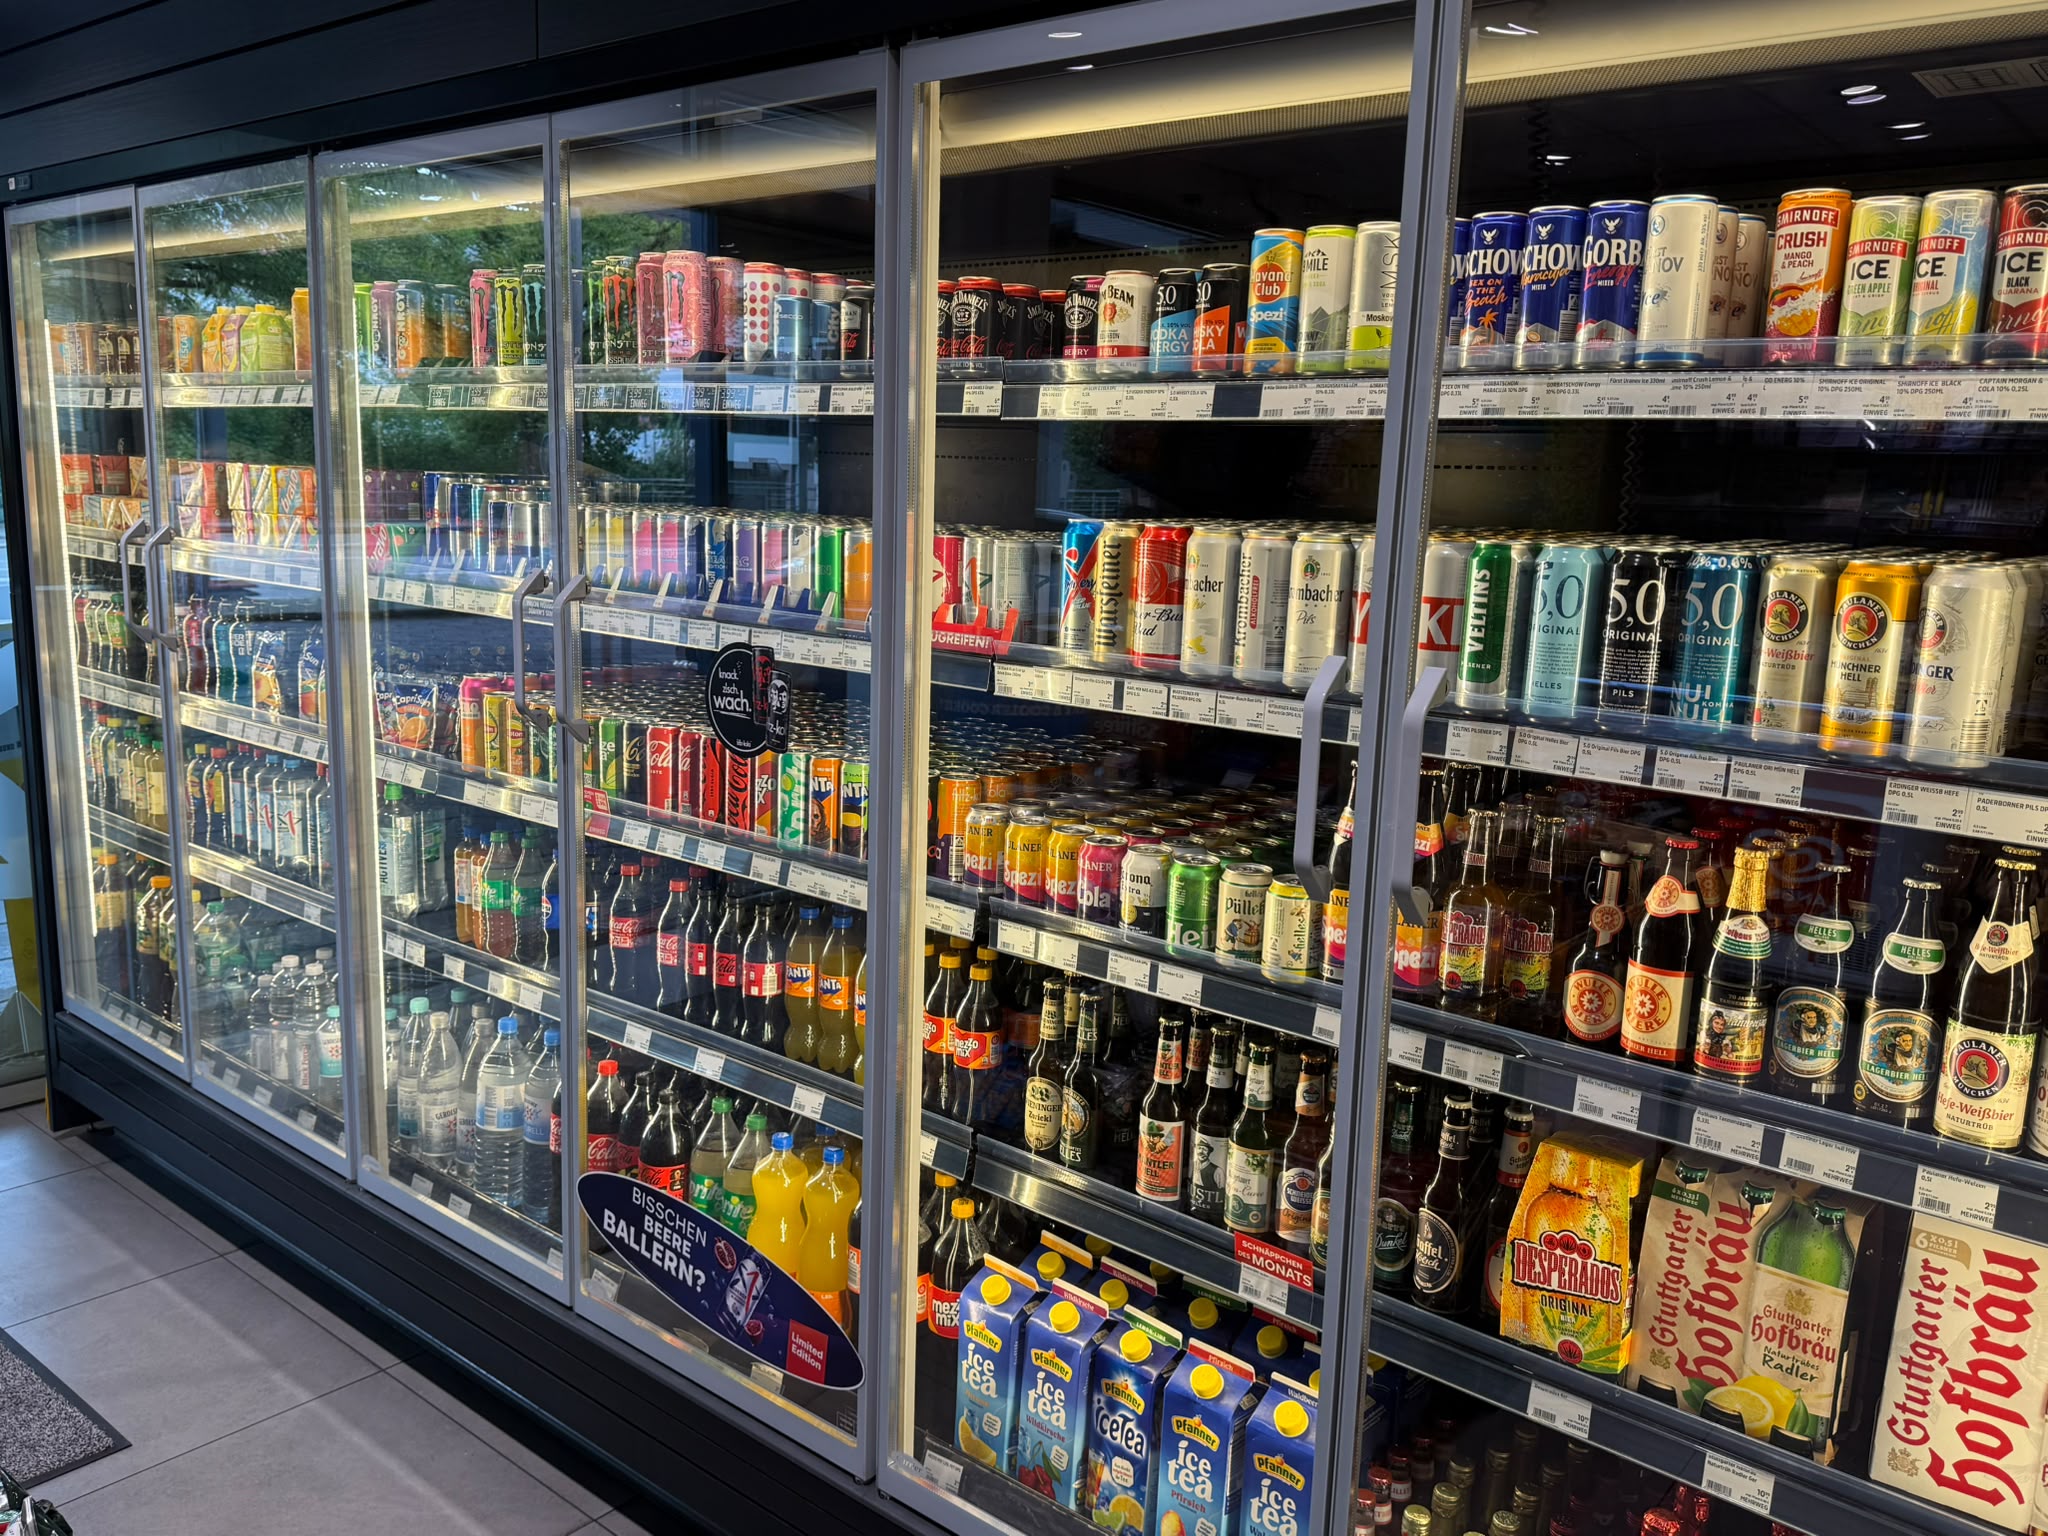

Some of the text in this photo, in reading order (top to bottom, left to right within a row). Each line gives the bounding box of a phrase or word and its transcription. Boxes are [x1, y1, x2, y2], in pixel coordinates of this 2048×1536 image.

[1777, 206, 1836, 228] SMIRNOFF
[1777, 231, 1828, 251] CRUSH
[1784, 251, 1812, 262] MANGO
[1788, 259, 1814, 268] PEACH
[1254, 282, 1281, 297] Club
[1476, 286, 1496, 295] THE
[1487, 278, 1502, 287] ON
[1867, 282, 1892, 294] APPLE
[2006, 277, 2029, 288] BLACK
[1106, 286, 1135, 308] BEAM
[1250, 307, 1284, 322] Spezi
[1064, 348, 1089, 356] BERRY
[1979, 377, 2006, 385] CAPTAIN
[2007, 377, 2036, 385] MORGAN
[1235, 551, 1252, 648] Krombacher
[1467, 568, 1491, 655] VELTINS
[1605, 578, 1666, 629] 5,0
[1681, 580, 1743, 631] 5,0
[1296, 610, 1316, 625] Pils
[1602, 628, 1663, 643] ORIGINAL
[1678, 632, 1740, 647] ORIGINAL
[1840, 670, 1862, 682] HELL
[1613, 689, 1635, 698] PILS
[1775, 797, 1799, 807] EINWEG
[1888, 781, 1919, 793] ERDINGER
[1943, 790, 1960, 798] HEFE
[1977, 797, 2039, 811] PADERBORNER PILS
[1936, 820, 1962, 831] EINWEG
[1808, 924, 1838, 938] HELLES
[1900, 944, 1932, 959] HELLES
[1627, 974, 1669, 999] WULLE
[1624, 1015, 1666, 1033] BIERE
[956, 1046, 972, 1058] mix
[1647, 1048, 1669, 1057] HELL
[1817, 1048, 1836, 1058] HELL
[1954, 1039, 2007, 1068] PAULANER
[1866, 1064, 1910, 1081] LAGERBIER
[1952, 1075, 1999, 1098] MÜNCHEN
[1938, 1091, 2015, 1122] Hefe-Weißbier
[1946, 1112, 1994, 1131] NATURTRÜB
[1730, 1147, 1759, 1160] MEHRWEG
[1822, 1171, 1853, 1186] MEHRWEG
[632, 1186, 707, 1248] BISSCHEN
[1960, 1208, 1994, 1224] MEHRWEG
[644, 1215, 692, 1259] BEERE
[603, 1208, 707, 1293] BALLERN?
[1241, 1239, 1304, 1269] SCHNÄPPCHEN
[1238, 1250, 1313, 1287] DES MONATS
[1514, 1240, 1622, 1303] DESPERADOS
[1540, 1294, 1595, 1319] ORIGINAL
[1649, 1201, 1754, 1388] Stuttgarter Hofbräu
[1762, 1304, 1833, 1337] Stuttgarter
[791, 1331, 824, 1360] Limited
[965, 1323, 1000, 1350] pfanner
[1750, 1312, 1837, 1365] Hofbräu
[791, 1344, 822, 1371] Edition
[967, 1343, 995, 1377] ice
[1033, 1350, 1070, 1379] pfanner
[1761, 1353, 1819, 1383] Radler
[1763, 1345, 1821, 1372] Naturtrübes
[961, 1361, 998, 1399] tea
[1036, 1371, 1066, 1406] ice
[1886, 1248, 2041, 1507] Stuttgarter Hofbräu
[1103, 1381, 1143, 1411] pfanner
[1027, 1388, 1067, 1430] tea
[1025, 1413, 1067, 1443] Wildkirsche
[1175, 1418, 1217, 1449] pfanner
[1177, 1440, 1212, 1478] ice
[1167, 1458, 1214, 1503] tea
[1257, 1456, 1302, 1488] pfanner
[1170, 1489, 1207, 1514] Pfirsich
[1260, 1478, 1297, 1518] ice
[1249, 1496, 1298, 1536] tea
